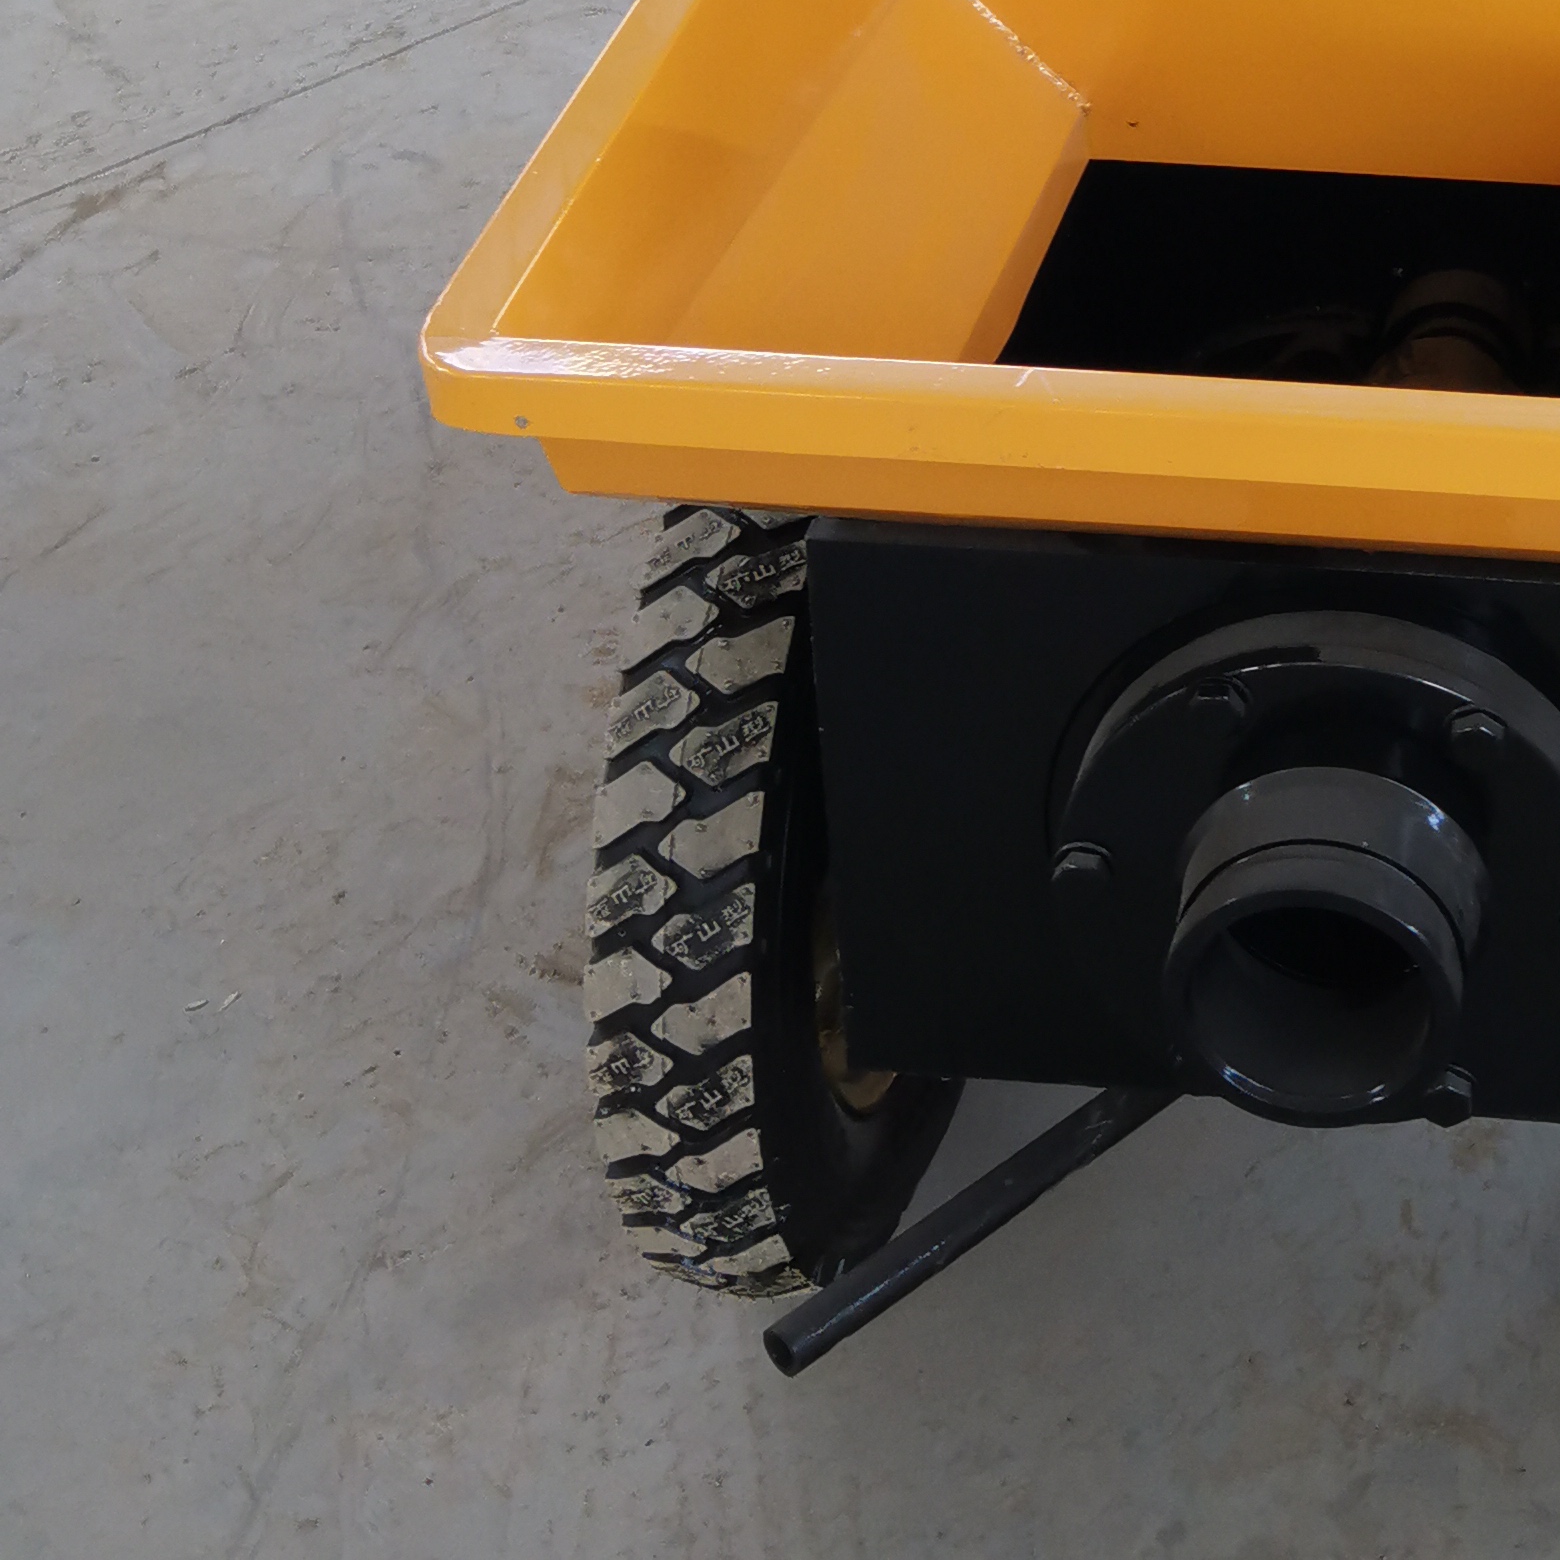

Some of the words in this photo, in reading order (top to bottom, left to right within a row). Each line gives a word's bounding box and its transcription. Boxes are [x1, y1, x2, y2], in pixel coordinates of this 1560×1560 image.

[687, 713, 771, 772] 矿山型
[588, 870, 658, 920] 矿山型
[666, 898, 750, 957] 矿山型
